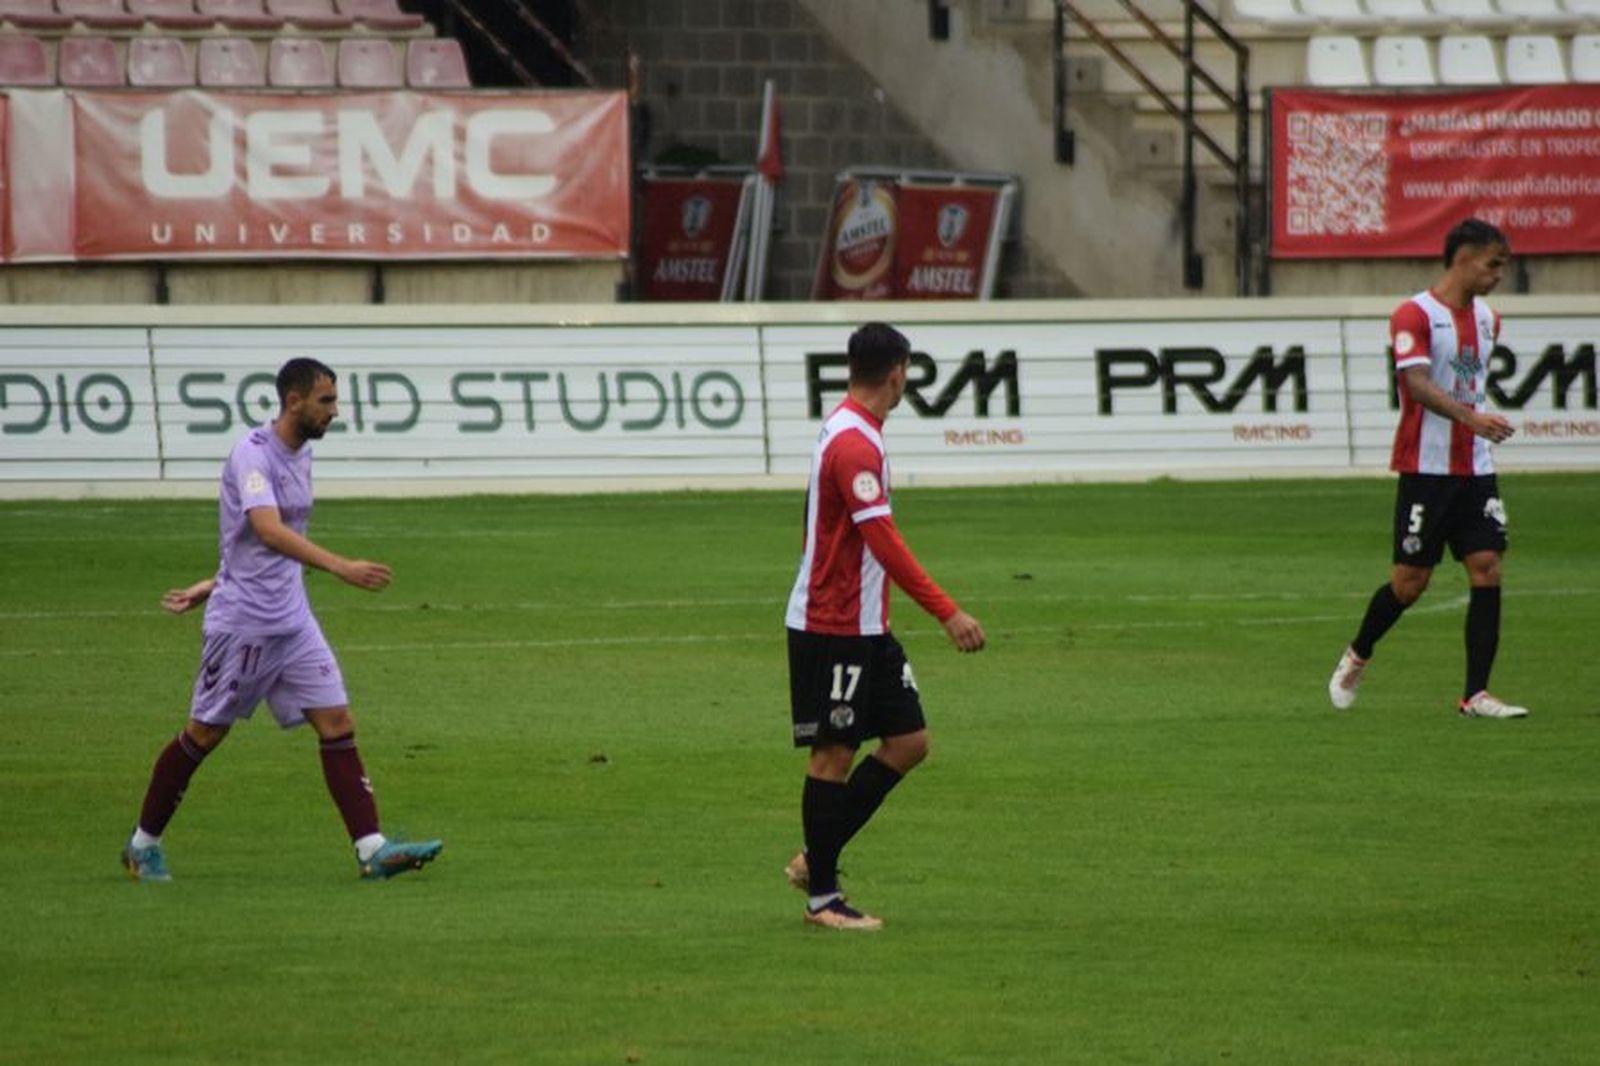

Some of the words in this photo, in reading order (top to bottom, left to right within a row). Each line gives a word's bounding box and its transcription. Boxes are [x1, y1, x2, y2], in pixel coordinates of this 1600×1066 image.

[1486, 109, 1592, 131] IMAGINADO
[141, 107, 558, 199] UEMC
[1521, 138, 1541, 155] EN
[151, 222, 553, 244] UNIVERSIDAD
[654, 257, 718, 283] AMSTEL
[907, 266, 976, 293] AMSTEL
[1095, 345, 1308, 416] PRM
[1387, 343, 1598, 410] RM
[179, 372, 421, 434] SOID
[450, 370, 745, 432] STUDIO
[944, 429, 1023, 446] RACING
[1233, 424, 1312, 441] RACING
[1408, 503, 1424, 533] 5
[830, 663, 862, 702] 17
